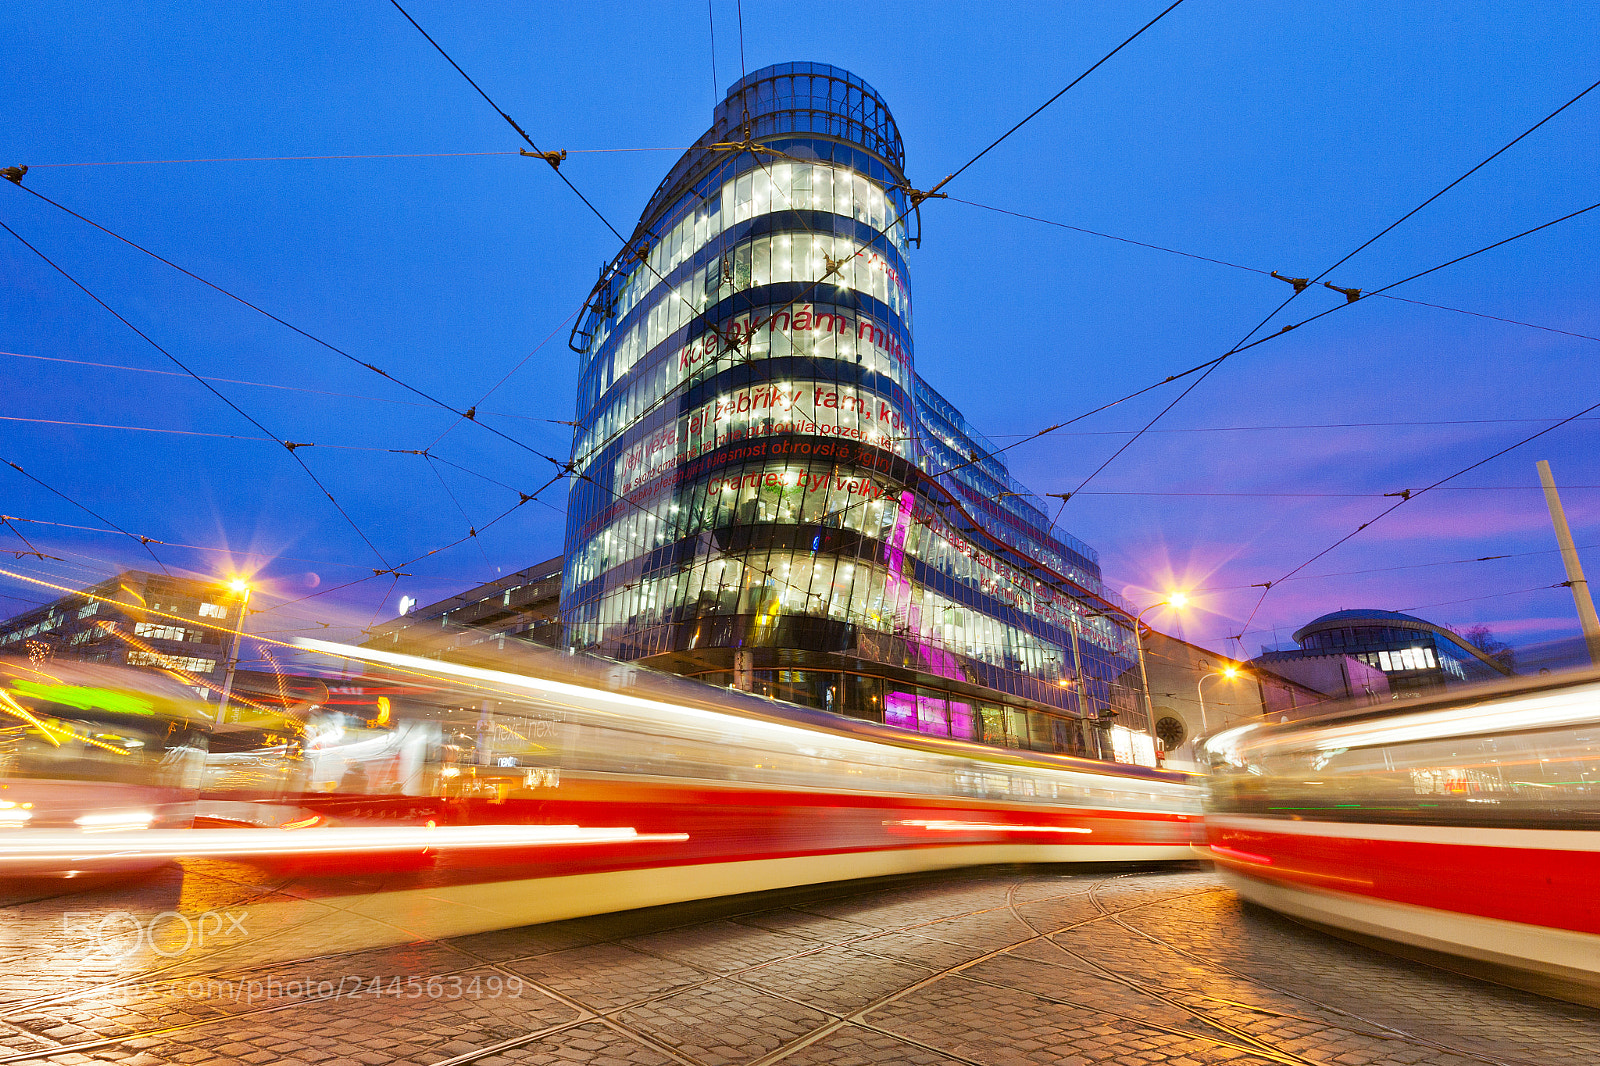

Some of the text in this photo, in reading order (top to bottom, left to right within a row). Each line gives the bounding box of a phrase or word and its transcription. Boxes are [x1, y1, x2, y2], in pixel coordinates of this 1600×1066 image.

[679, 334, 718, 372] kde
[724, 316, 761, 346] by
[771, 304, 847, 335] nám
[646, 428, 680, 459] věže,
[684, 404, 712, 444] její
[713, 385, 803, 423] žebříky
[815, 387, 872, 420] tam,
[701, 439, 713, 454] na
[797, 468, 832, 493] byl
